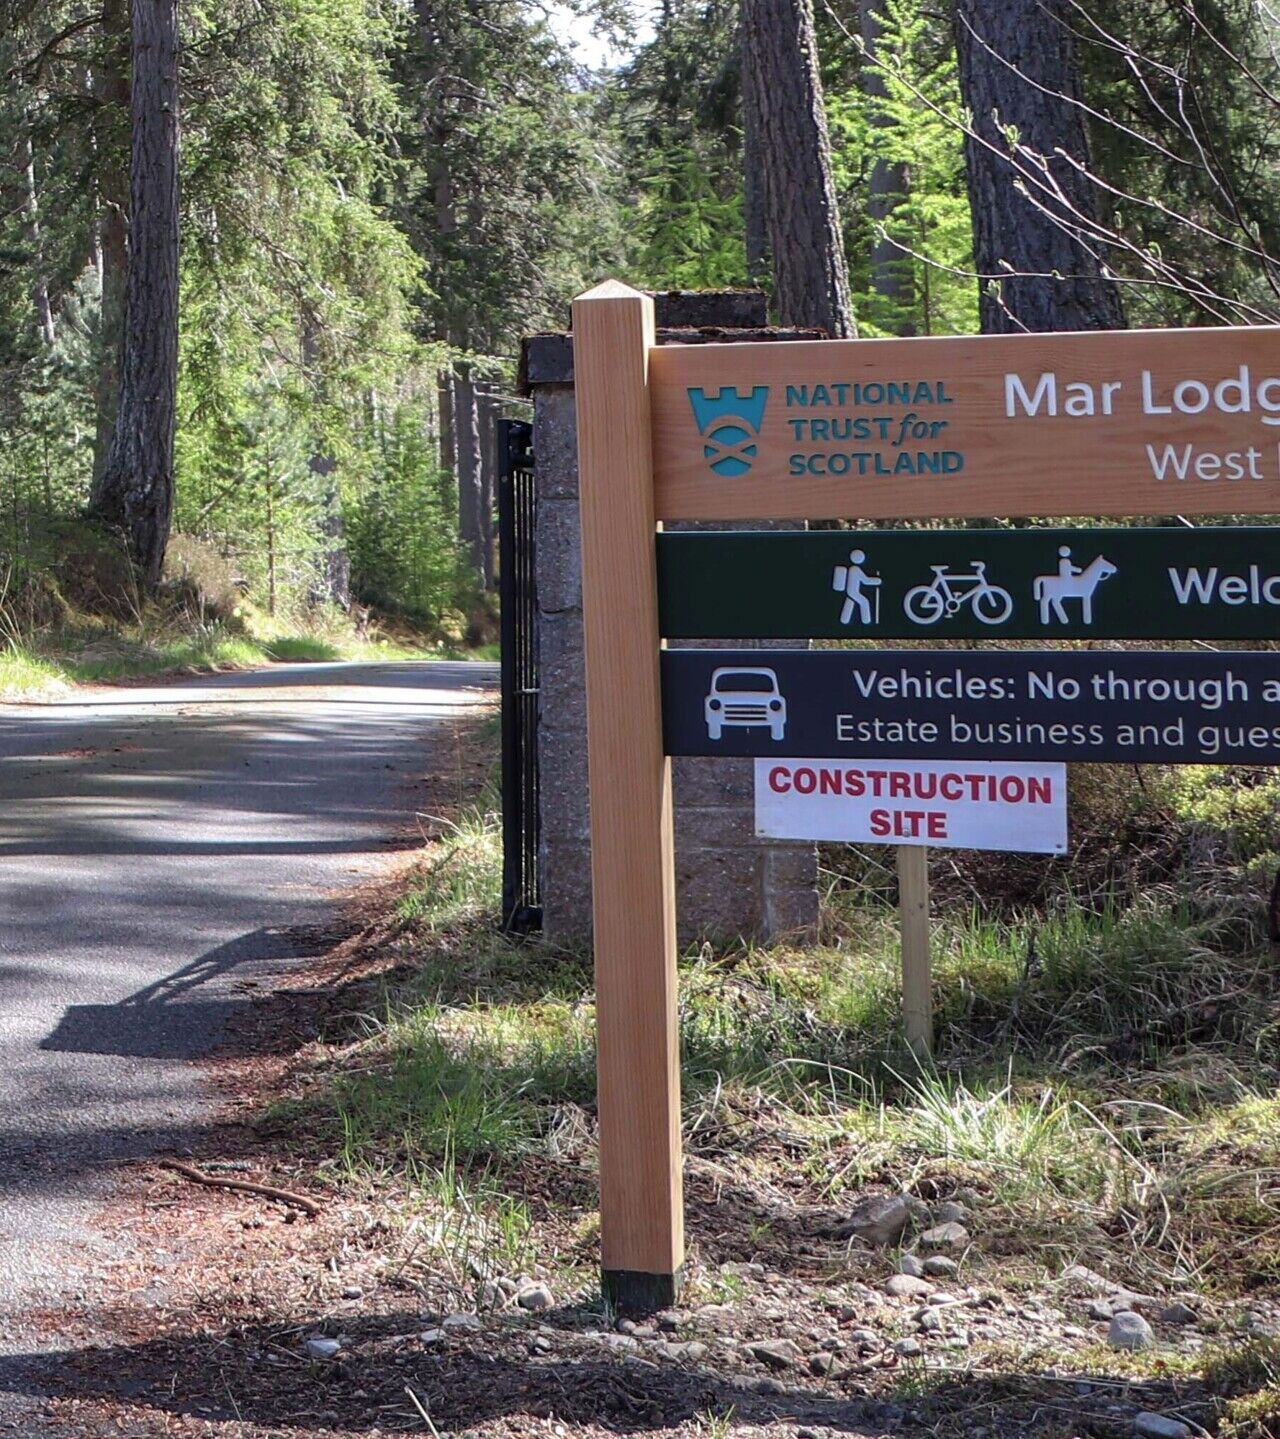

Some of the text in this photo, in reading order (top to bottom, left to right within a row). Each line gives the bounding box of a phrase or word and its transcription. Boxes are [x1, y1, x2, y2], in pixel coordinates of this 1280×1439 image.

[786, 381, 953, 407] NATIONAL
[1005, 372, 1122, 417] Mar
[788, 412, 948, 446] TRUST for
[789, 451, 965, 476] SCOTLAND
[1145, 443, 1264, 480] West
[852, 668, 1016, 700] Vehicles:
[1027, 671, 1080, 701] No
[1091, 670, 1248, 710] through
[836, 714, 939, 743] Estate
[950, 714, 1104, 746] business
[1116, 716, 1185, 747] and
[768, 767, 1052, 805] CONSTRUCTION
[870, 809, 948, 839] SITE
